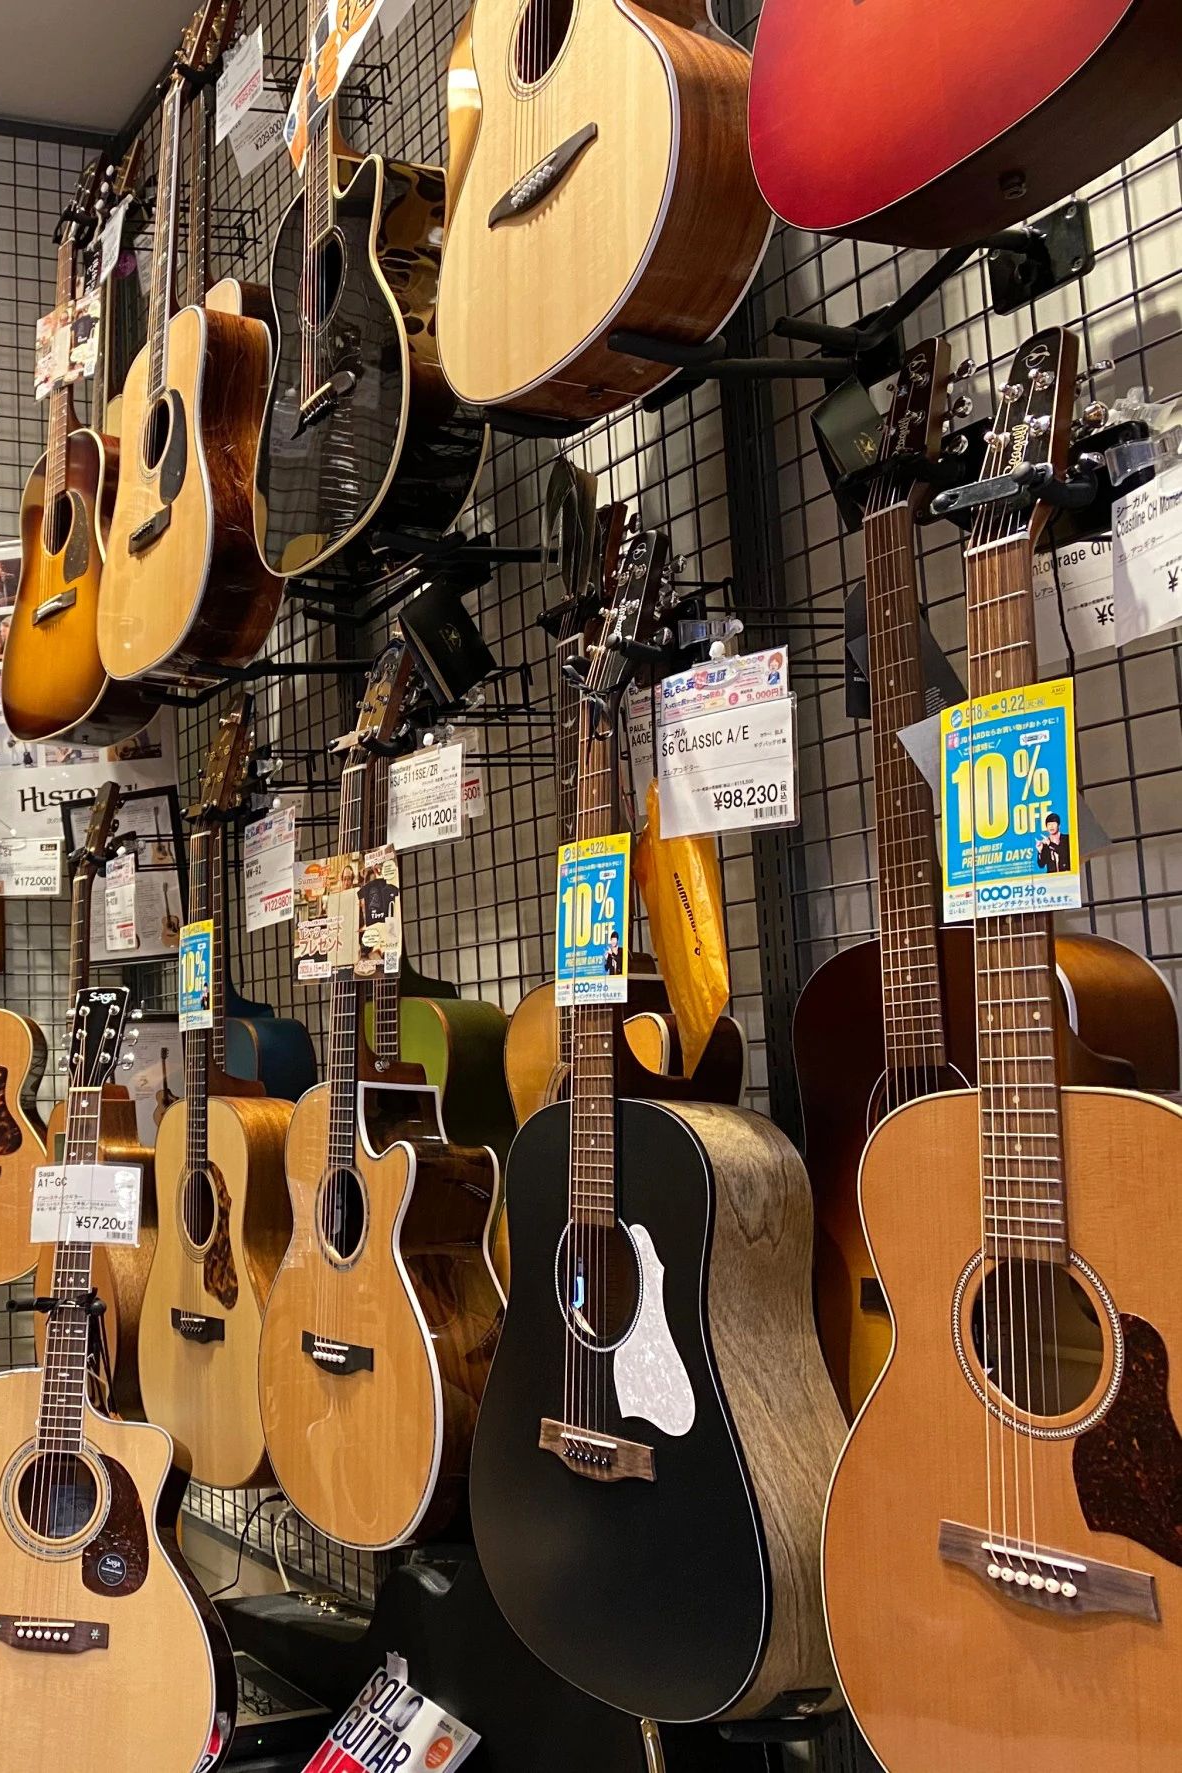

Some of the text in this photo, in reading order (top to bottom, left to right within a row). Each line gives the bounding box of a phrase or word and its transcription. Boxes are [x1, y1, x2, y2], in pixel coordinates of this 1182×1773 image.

[1116, 511, 1146, 538] Coastline
[1147, 500, 1158, 521] CH
[1031, 549, 1087, 577] ntourage
[1000, 694, 1025, 714] 9.22
[629, 724, 645, 735] PAUL
[662, 725, 750, 757] S6 CLASSIC A/E
[713, 783, 778, 811] ¥98,230
[952, 744, 1050, 844] 10%
[1013, 800, 1053, 836] OFF
[1005, 847, 1034, 861] DAYS
[562, 879, 616, 948] 10%
[593, 921, 616, 946] OFF
[89, 991, 118, 1004] Saga
[37, 1176, 68, 1188] A1-GC
[359, 1670, 424, 1733] SOLO
[332, 1705, 412, 1773] GUITAR
